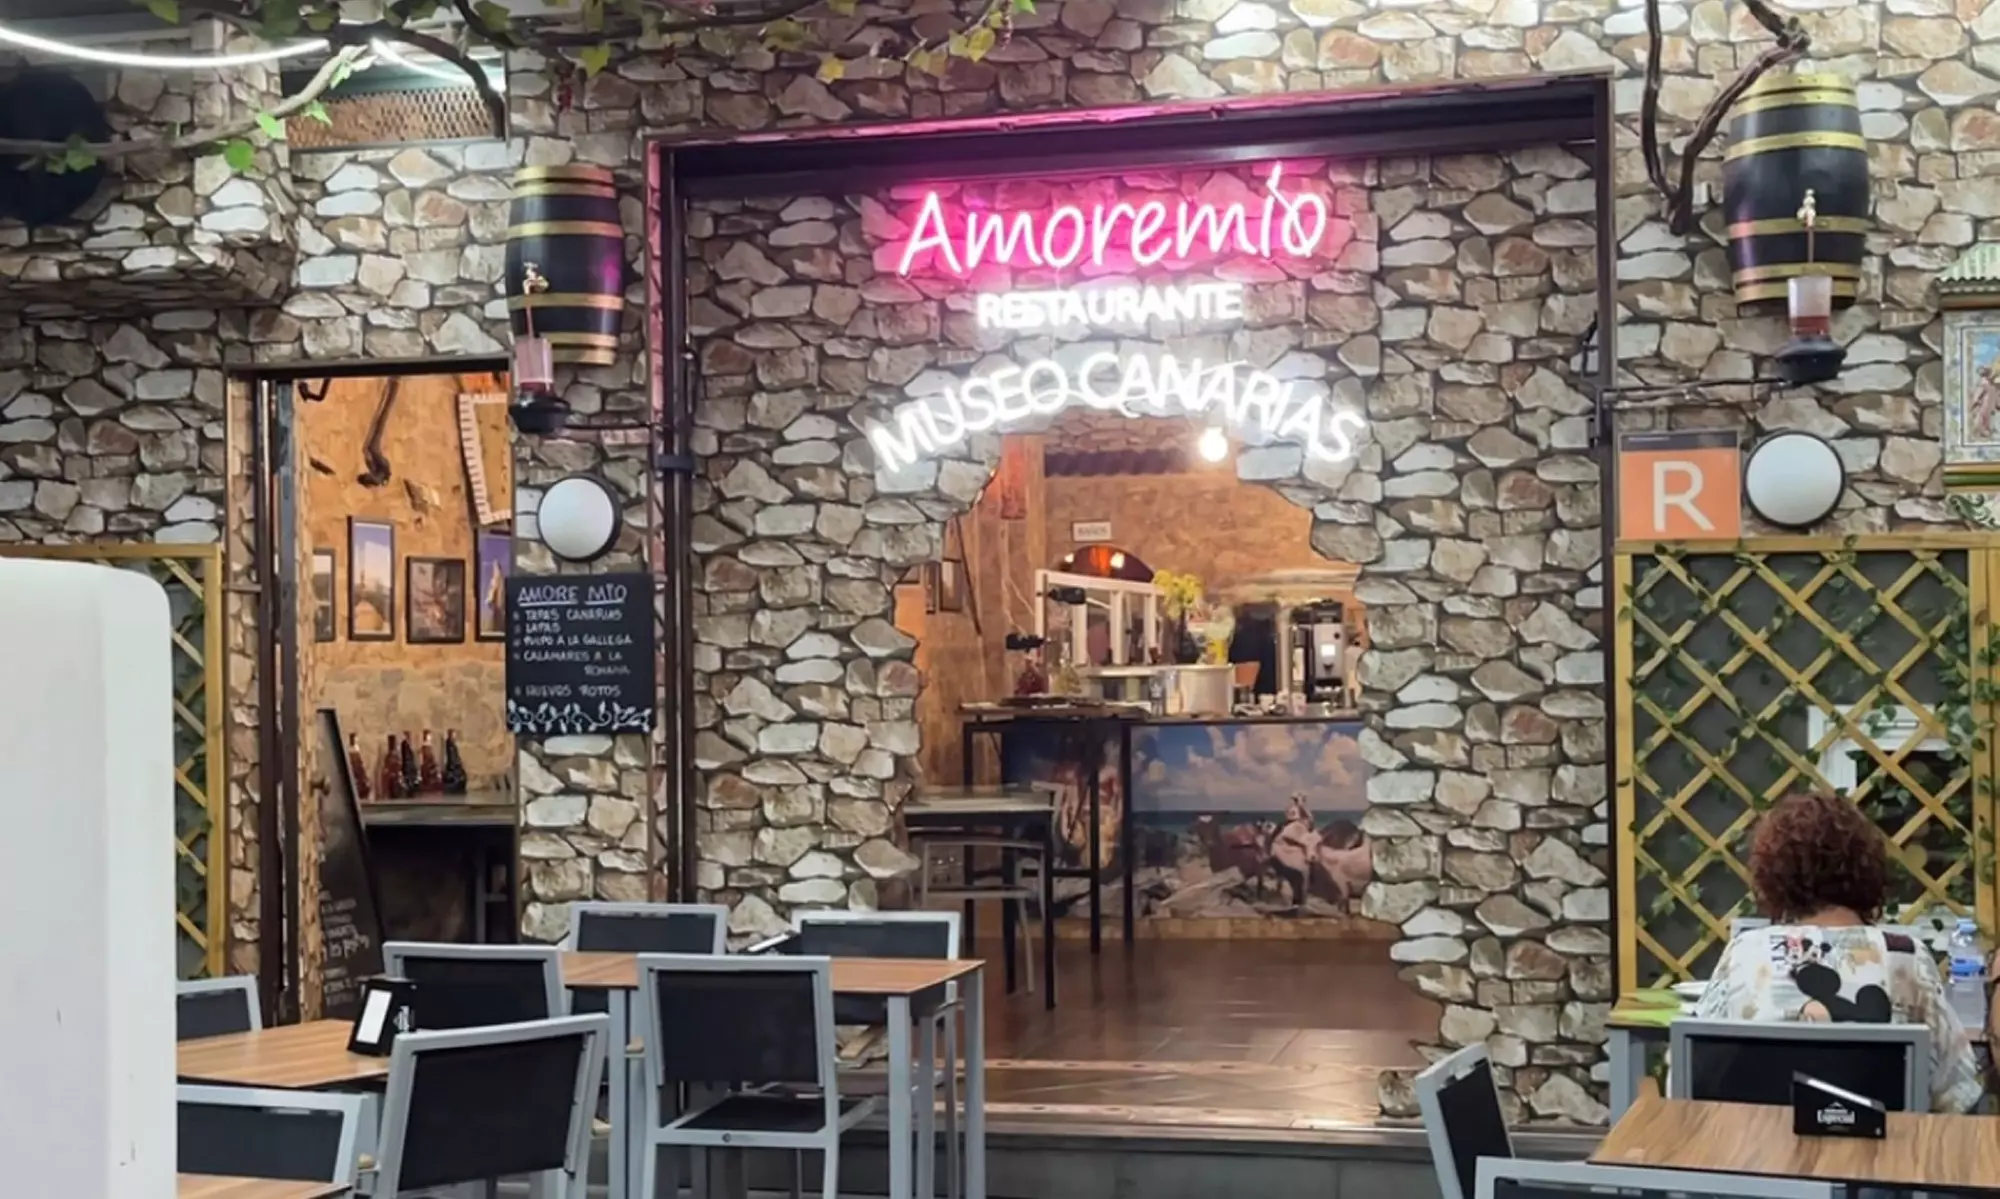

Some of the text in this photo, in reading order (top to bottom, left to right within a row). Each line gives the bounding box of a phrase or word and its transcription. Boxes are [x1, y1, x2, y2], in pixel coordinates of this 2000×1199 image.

[978, 282, 1243, 328] RESTAURANTE
[870, 352, 1366, 473] MUSEO CANARIAS
[1653, 460, 1716, 532] R
[517, 585, 580, 602] AMORE
[525, 609, 560, 621] TAPAS
[556, 636, 565, 646] A
[567, 635, 580, 646] LA
[582, 633, 633, 646] GALLEGA
[523, 650, 623, 662] CALAMARES A LA
